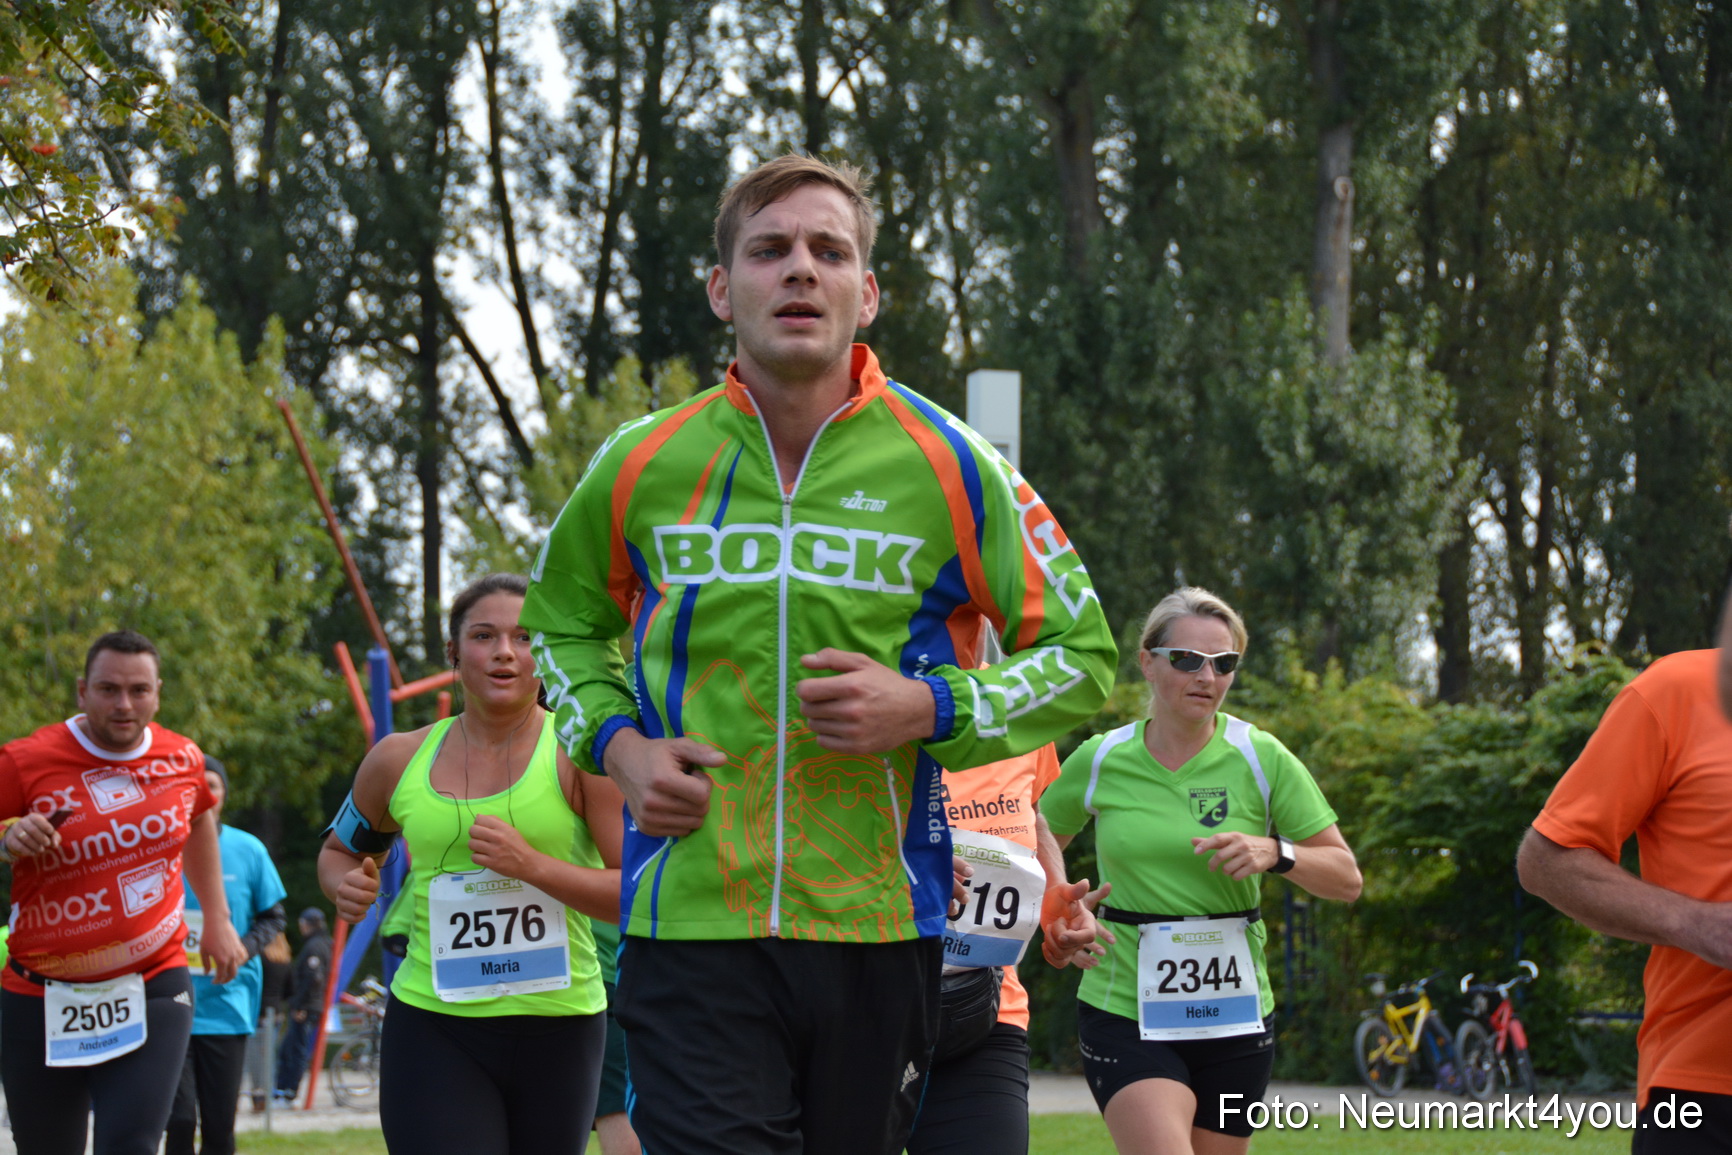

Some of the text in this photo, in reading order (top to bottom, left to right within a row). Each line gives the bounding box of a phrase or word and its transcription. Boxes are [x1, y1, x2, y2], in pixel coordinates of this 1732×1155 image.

[653, 523, 925, 594] BOCK
[89, 853, 138, 873] wohnen
[965, 846, 1010, 865] BOCK
[477, 879, 523, 892] BOCK
[64, 917, 113, 937] outdoor
[449, 904, 546, 950] 2576
[1184, 931, 1223, 943] BOCK
[944, 936, 971, 957] Rita
[481, 959, 520, 976] Maria
[1156, 955, 1242, 994] 2344
[62, 998, 130, 1033] 2505
[1186, 1005, 1219, 1019] Heike
[79, 1036, 119, 1051] Andreas
